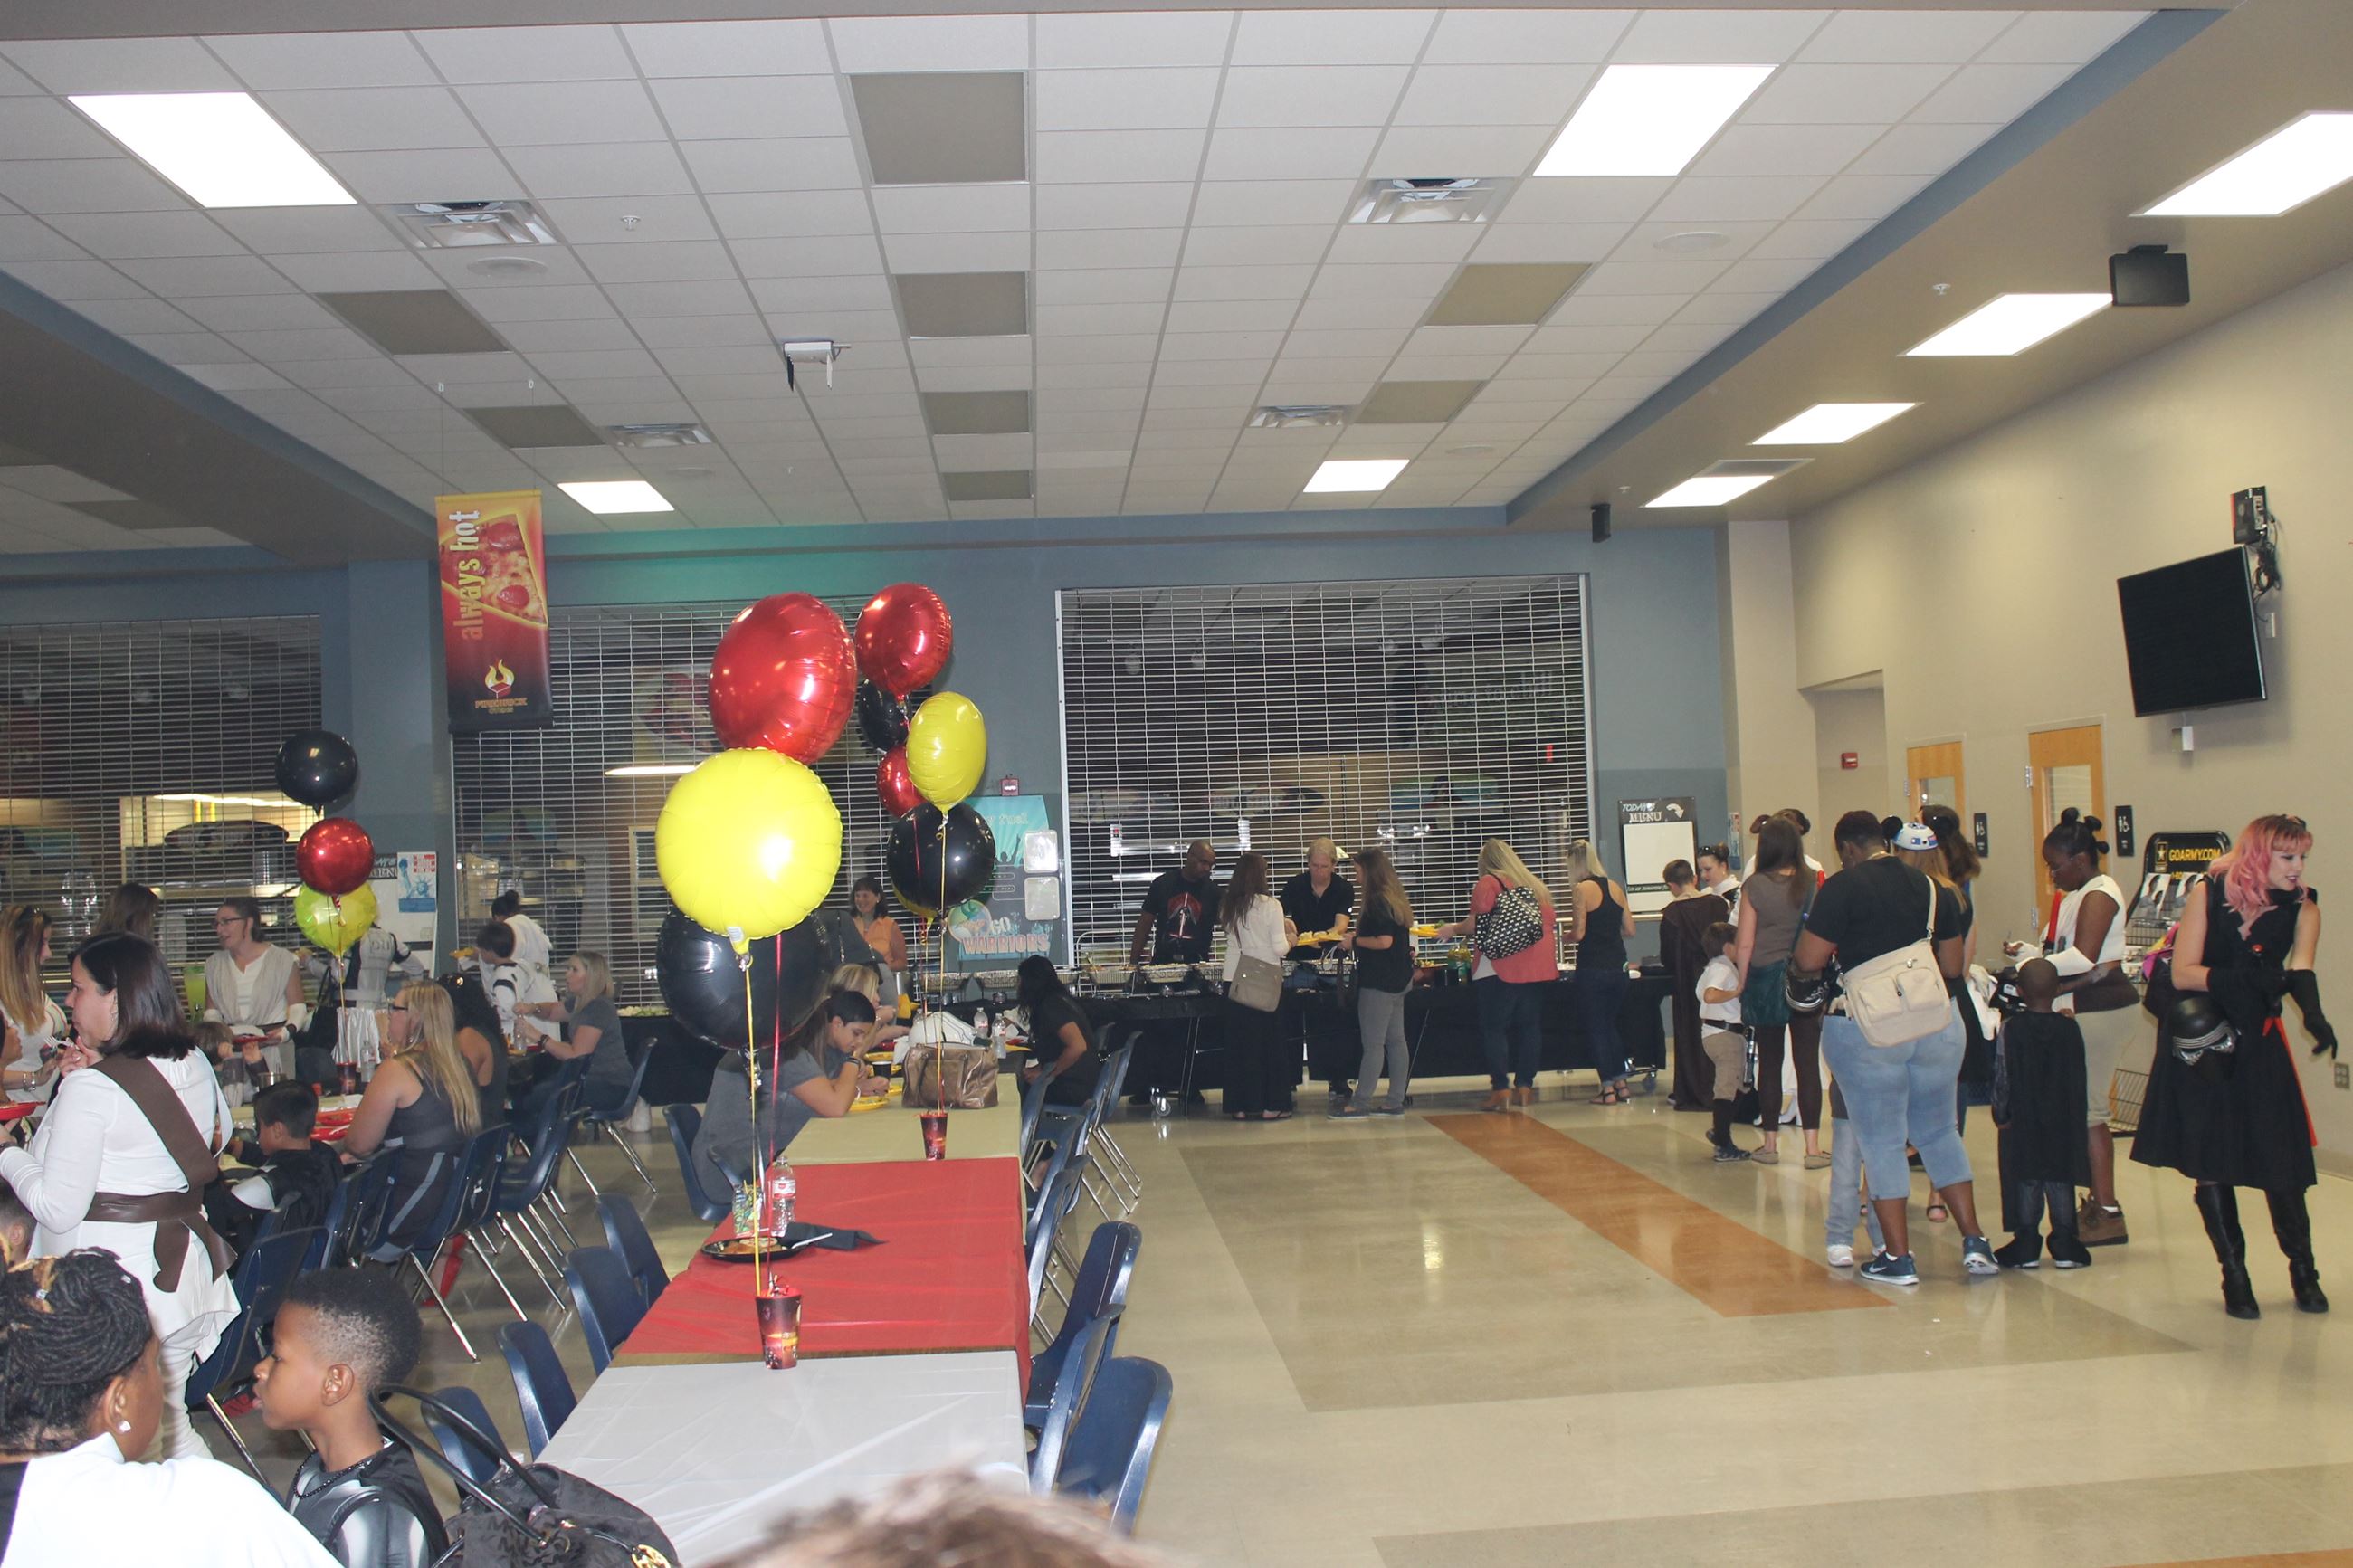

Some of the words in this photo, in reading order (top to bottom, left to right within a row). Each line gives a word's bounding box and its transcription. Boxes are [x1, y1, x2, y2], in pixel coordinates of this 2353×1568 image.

[449, 511, 480, 551] hot
[453, 558, 486, 641] always
[1623, 803, 1655, 813] TODAYS
[1629, 811, 1662, 822] MENU
[2169, 848, 2221, 861] GOARMY.COM
[991, 917, 1011, 934] GO
[963, 933, 1050, 955] WARRIORS
